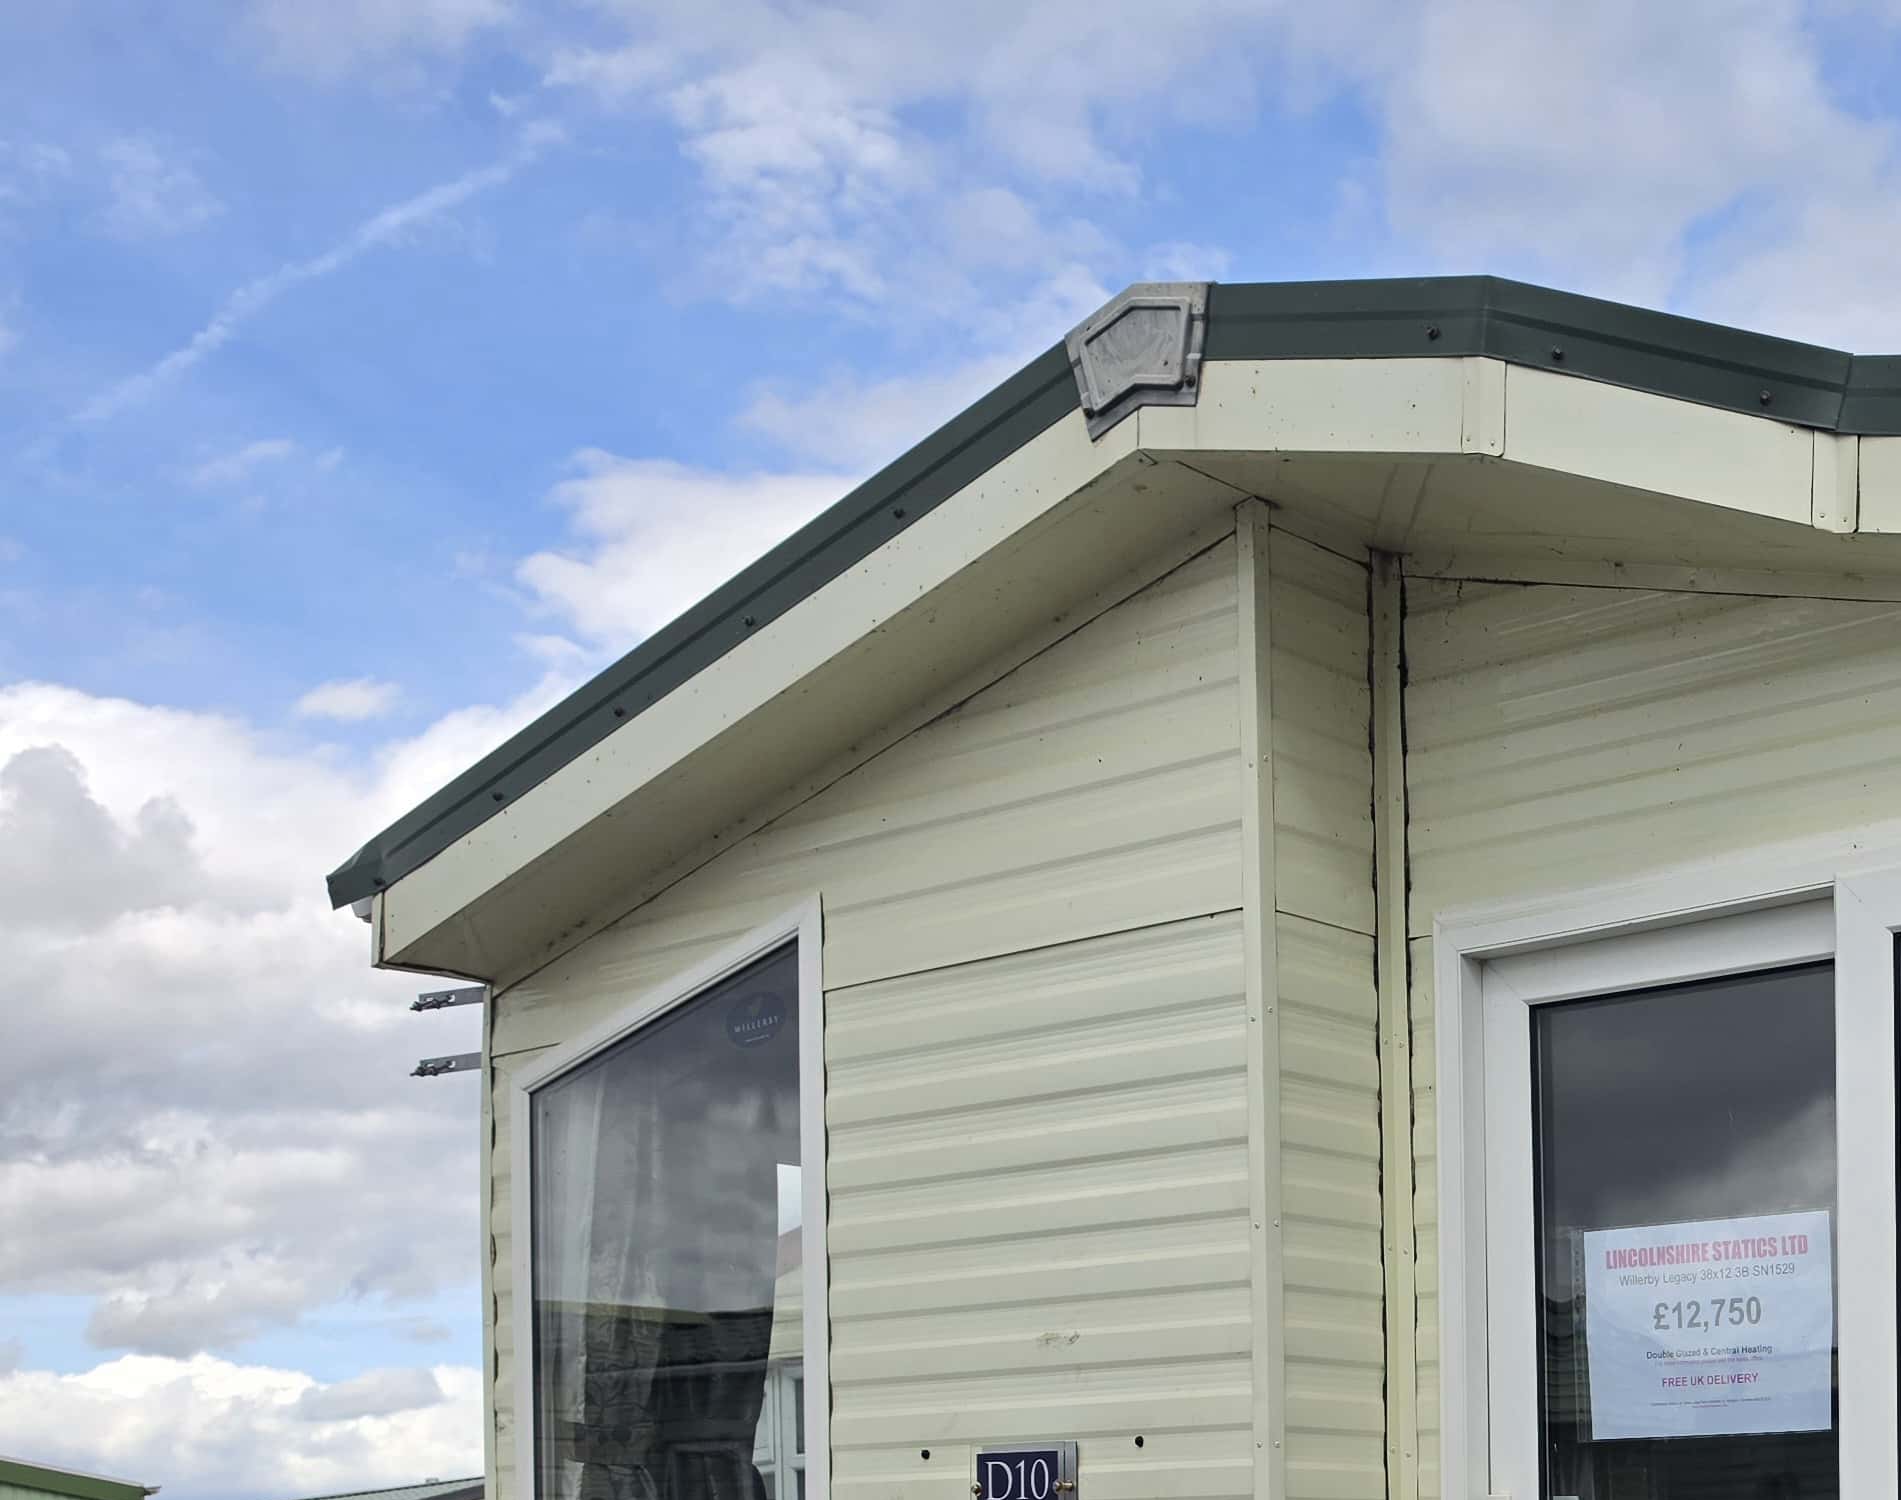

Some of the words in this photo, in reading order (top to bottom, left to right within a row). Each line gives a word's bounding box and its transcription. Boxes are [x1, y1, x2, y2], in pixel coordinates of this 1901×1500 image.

[1605, 1243, 1709, 1269] LINCOLNSHIRE
[1711, 1237, 1778, 1262] STATICS
[1781, 1234, 1809, 1255] LTD
[1618, 1275, 1660, 1288] Willerby
[1663, 1271, 1697, 1285] Legacy
[1700, 1267, 1732, 1281] 38x12
[1735, 1267, 1750, 1278] 3B
[1752, 1262, 1795, 1276] SN1529
[1653, 1296, 1762, 1332] £12,750
[1646, 1350, 1675, 1359] Double
[1662, 1378, 1688, 1388] FREE
[1690, 1376, 1706, 1386] UK
[1707, 1373, 1759, 1385] DELIVERY
[985, 1458, 1050, 1500] D10
